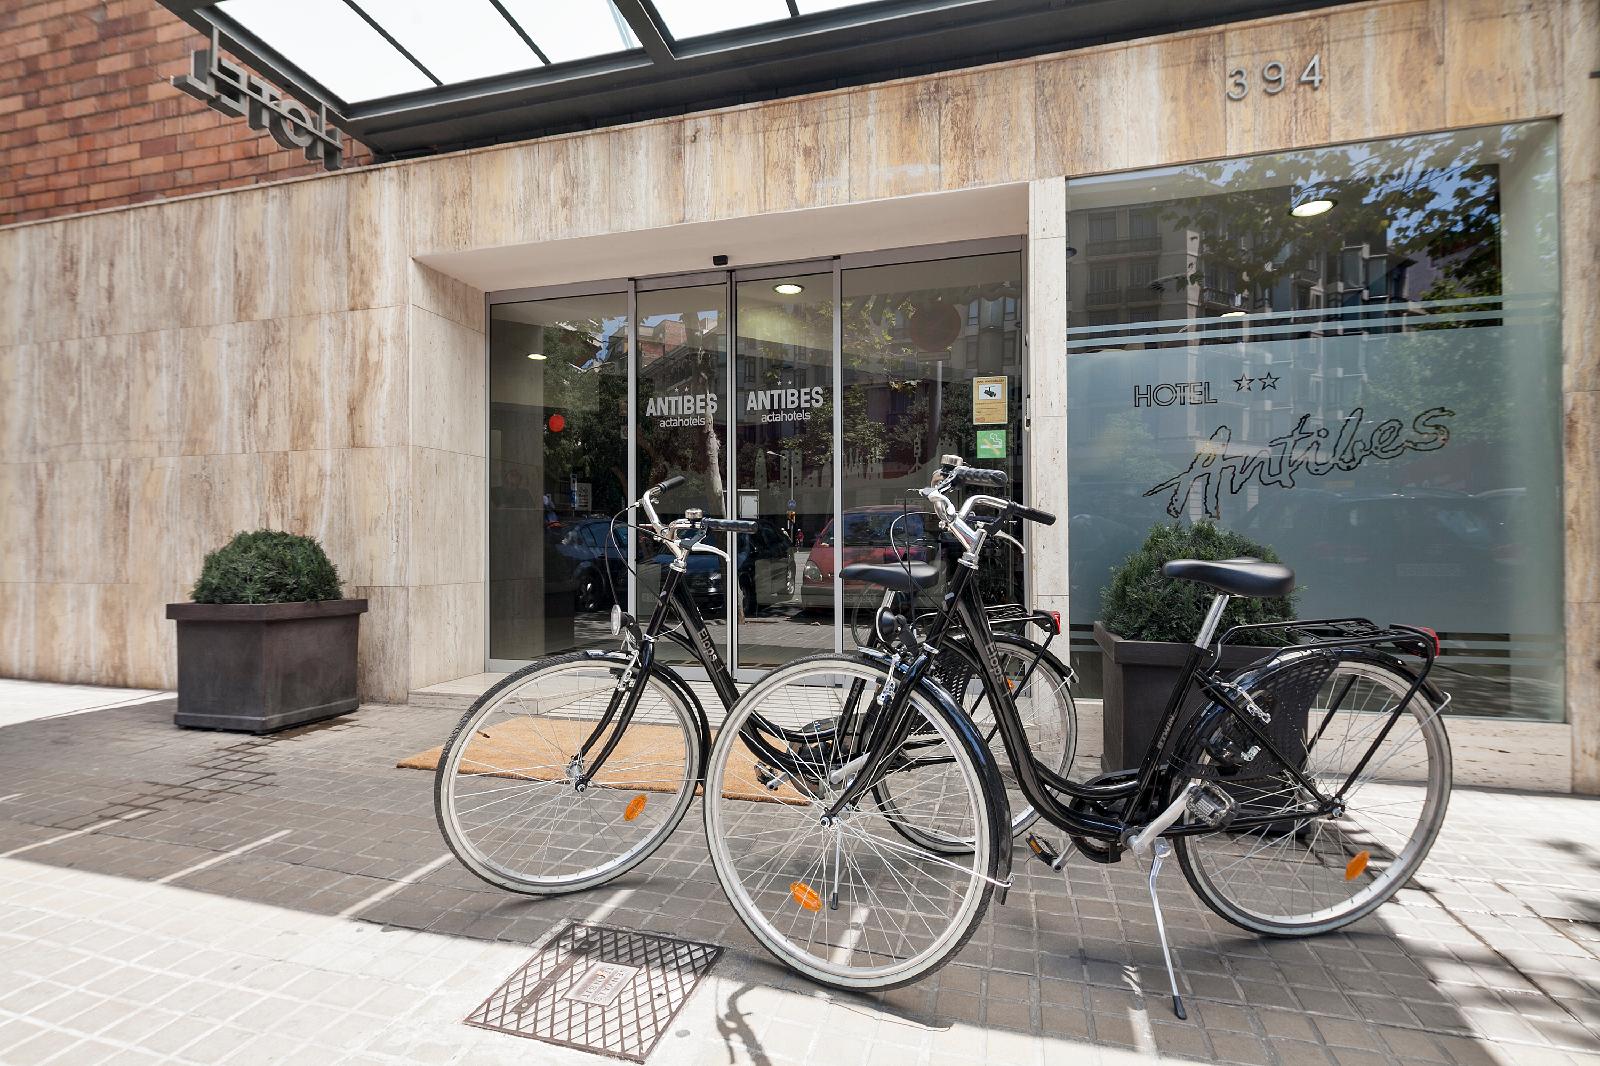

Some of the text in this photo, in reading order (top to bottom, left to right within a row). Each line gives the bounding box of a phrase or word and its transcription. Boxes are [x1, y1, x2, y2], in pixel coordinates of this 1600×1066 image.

[1226, 53, 1323, 100] 394
[646, 393, 718, 417] ANTIBES
[746, 386, 824, 411] ANTIBES
[1134, 382, 1218, 407] HOTEL
[659, 416, 707, 428] actahotels
[761, 410, 811, 423] actahotels
[1142, 407, 1456, 520] Antibes
[698, 628, 718, 662] Elops
[985, 641, 1005, 684] Elops
